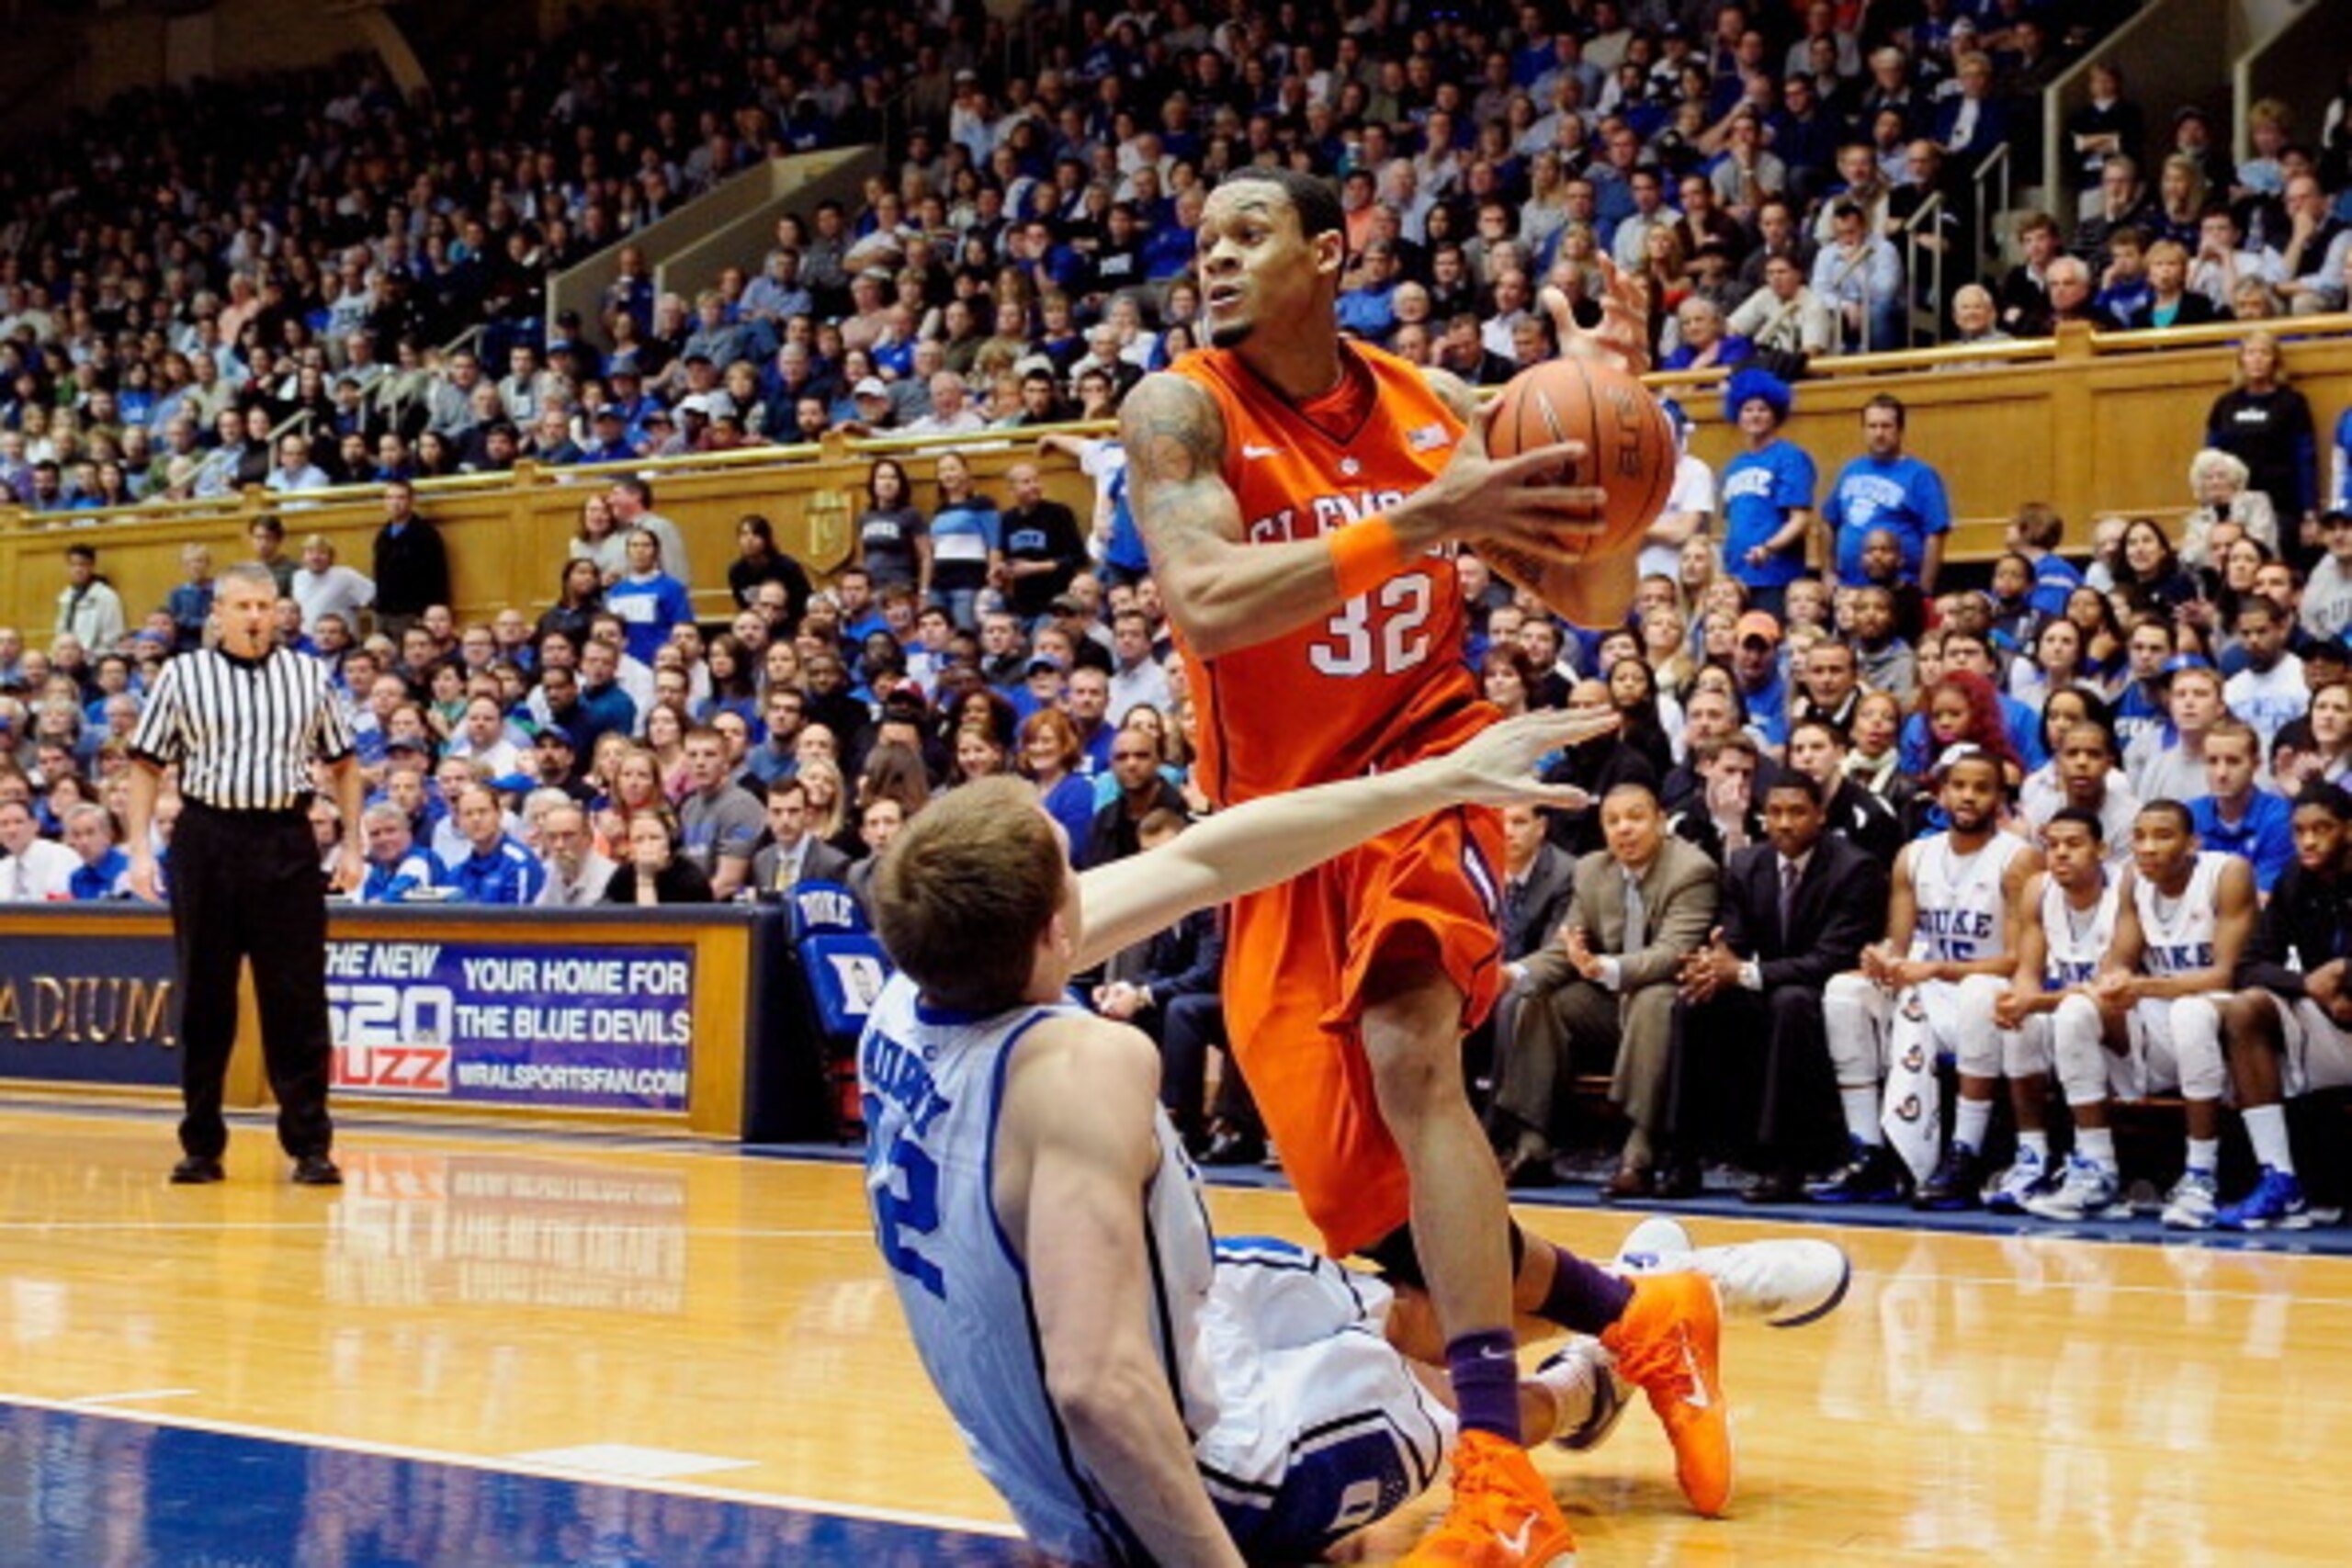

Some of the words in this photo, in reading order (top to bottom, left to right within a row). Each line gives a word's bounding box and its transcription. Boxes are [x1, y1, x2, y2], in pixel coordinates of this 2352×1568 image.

[1309, 573, 1430, 676] 32
[369, 943, 441, 979] NEW
[462, 958, 537, 992] YOUR
[542, 960, 623, 994] HOME
[629, 962, 688, 995] FOR
[456, 1005, 509, 1039] THE
[514, 1008, 587, 1042] BLUE
[593, 1010, 691, 1045] DEVILS
[329, 1047, 448, 1090] UZZ
[457, 1063, 686, 1095] WRALSPORTSFAN.COM
